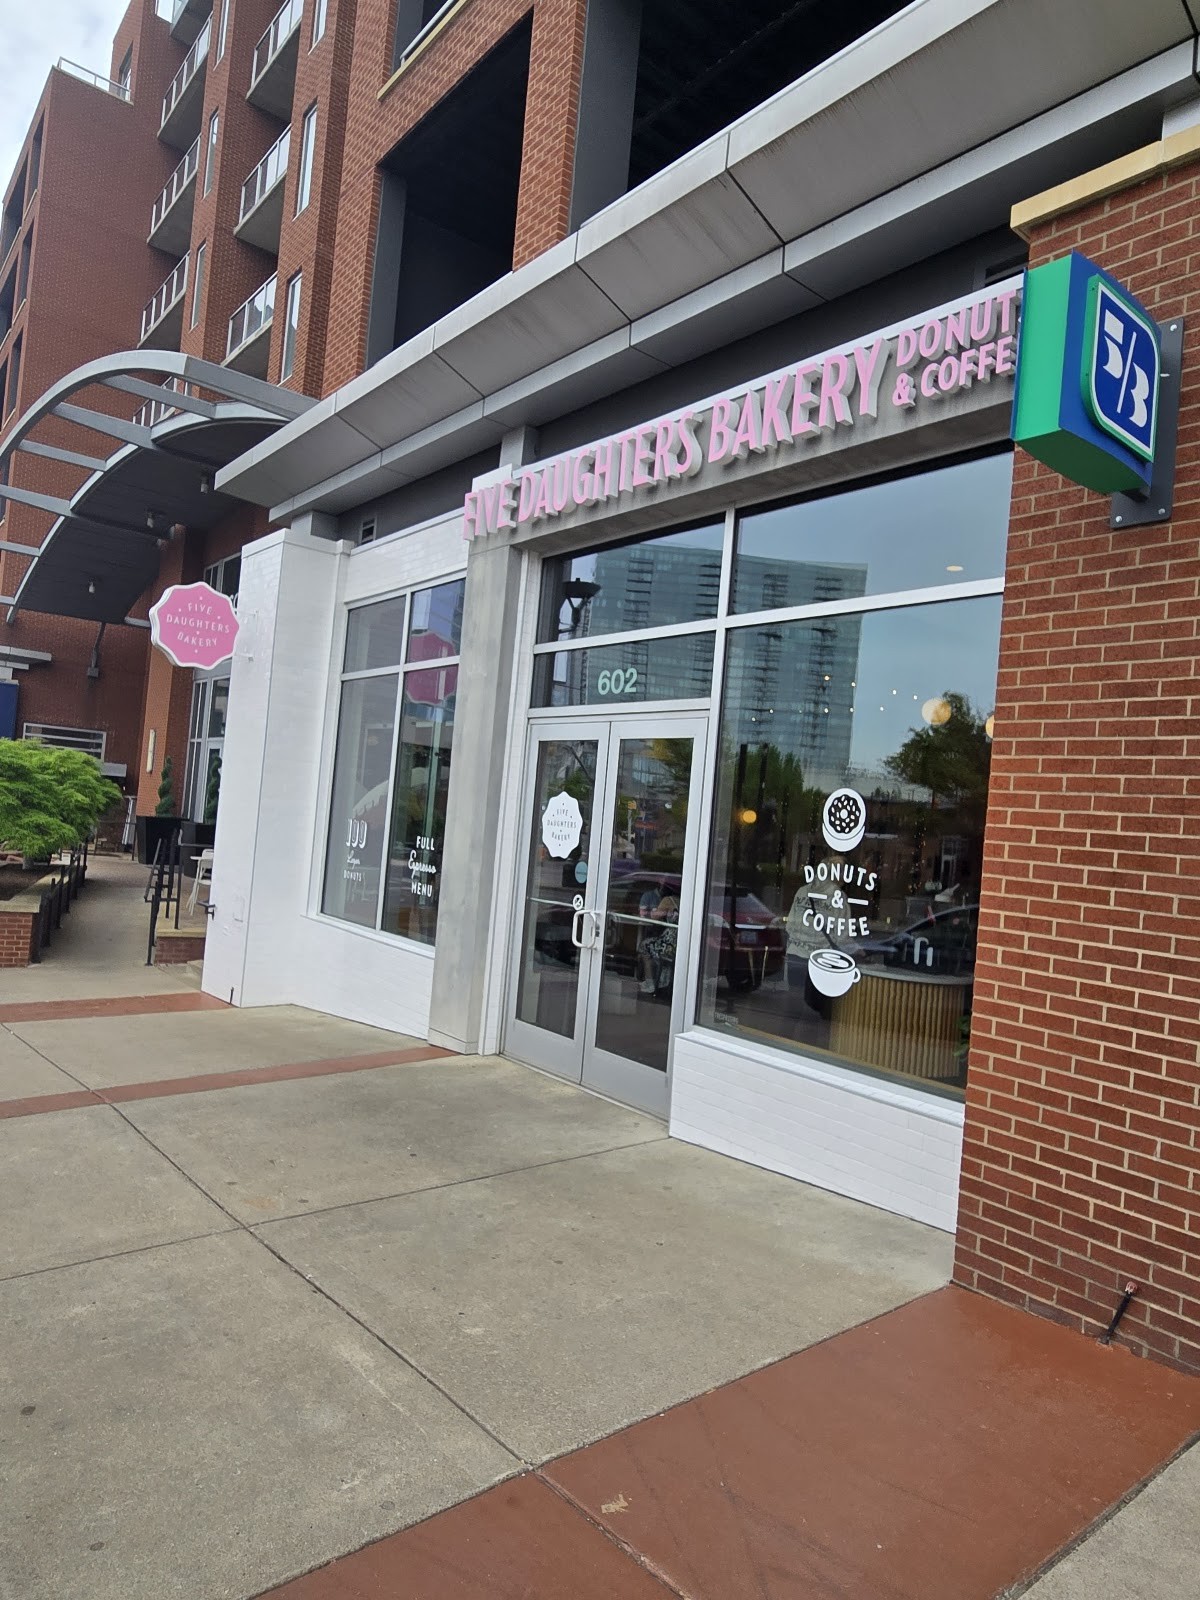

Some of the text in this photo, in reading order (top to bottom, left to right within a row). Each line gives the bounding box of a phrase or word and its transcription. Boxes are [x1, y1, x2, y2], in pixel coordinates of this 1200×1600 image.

[896, 289, 1021, 367] DONUT
[893, 335, 1015, 408] & COFFE
[464, 337, 889, 540] FIVE DAUGHTERS BAKERY
[188, 602, 212, 615] FIVE
[166, 614, 230, 634] DAUGHTERS
[177, 632, 217, 647] BAKERY
[597, 667, 638, 695] 602
[556, 808, 569, 816] FIVE
[547, 820, 577, 829] DAUGHTERS
[416, 835, 435, 851] FULL
[804, 863, 878, 891] DONUTS
[411, 880, 433, 897] MENU
[831, 890, 844, 909] &
[802, 909, 870, 937] COFFEE
